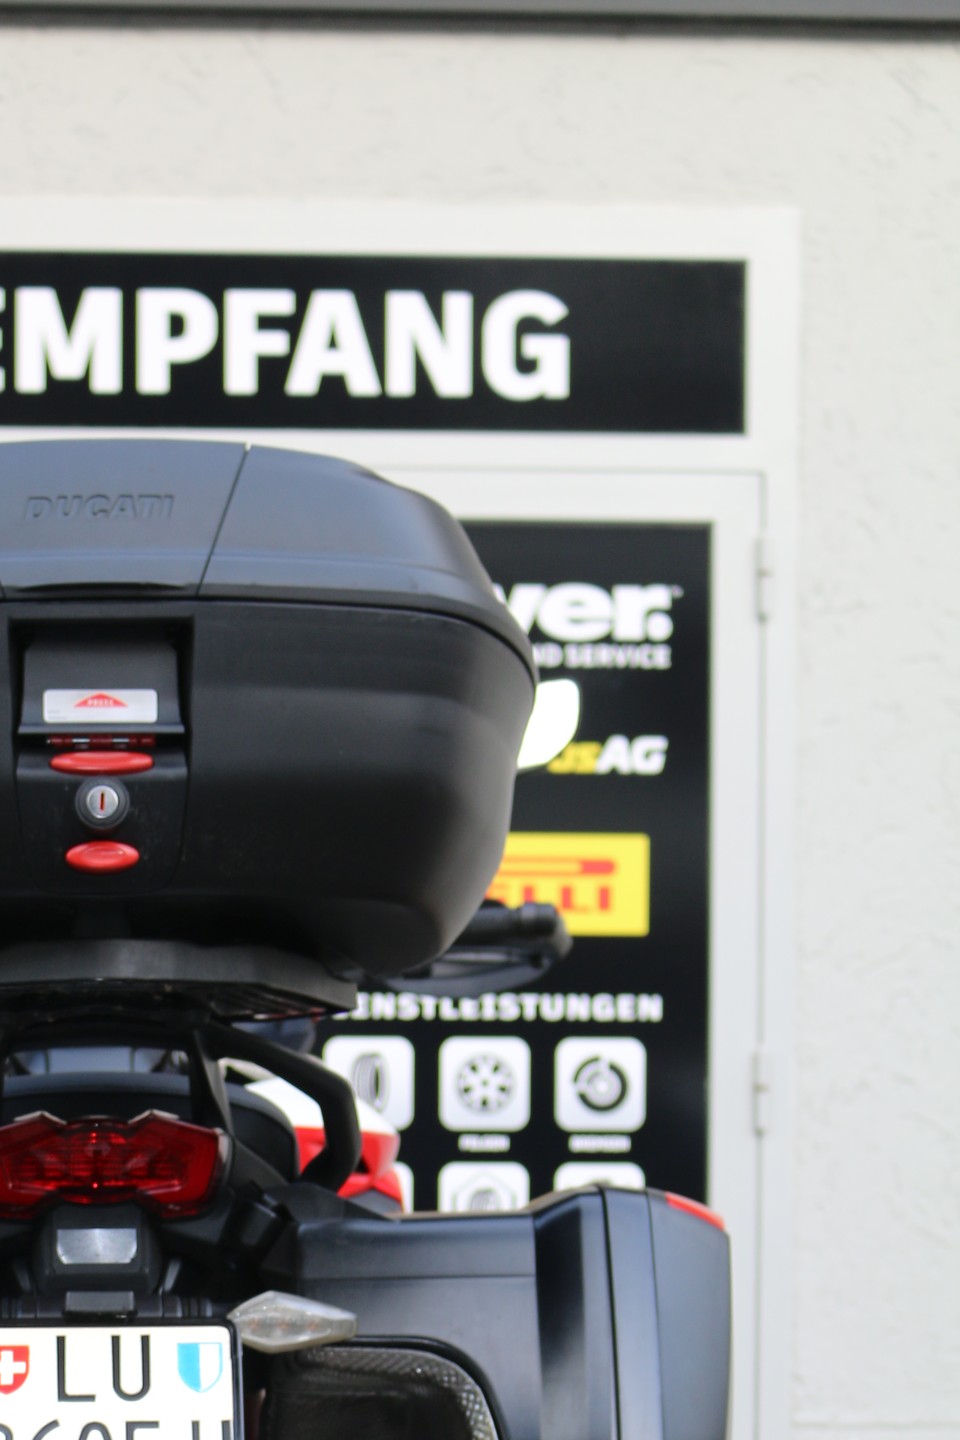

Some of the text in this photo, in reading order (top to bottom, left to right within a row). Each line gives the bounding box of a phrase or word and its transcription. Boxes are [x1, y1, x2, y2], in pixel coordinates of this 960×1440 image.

[25, 494, 174, 521] DUCATI
[564, 643, 672, 670] SERVICE
[332, 991, 664, 1023] ENSTLEISTUNGEN
[55, 1334, 151, 1402] LU
